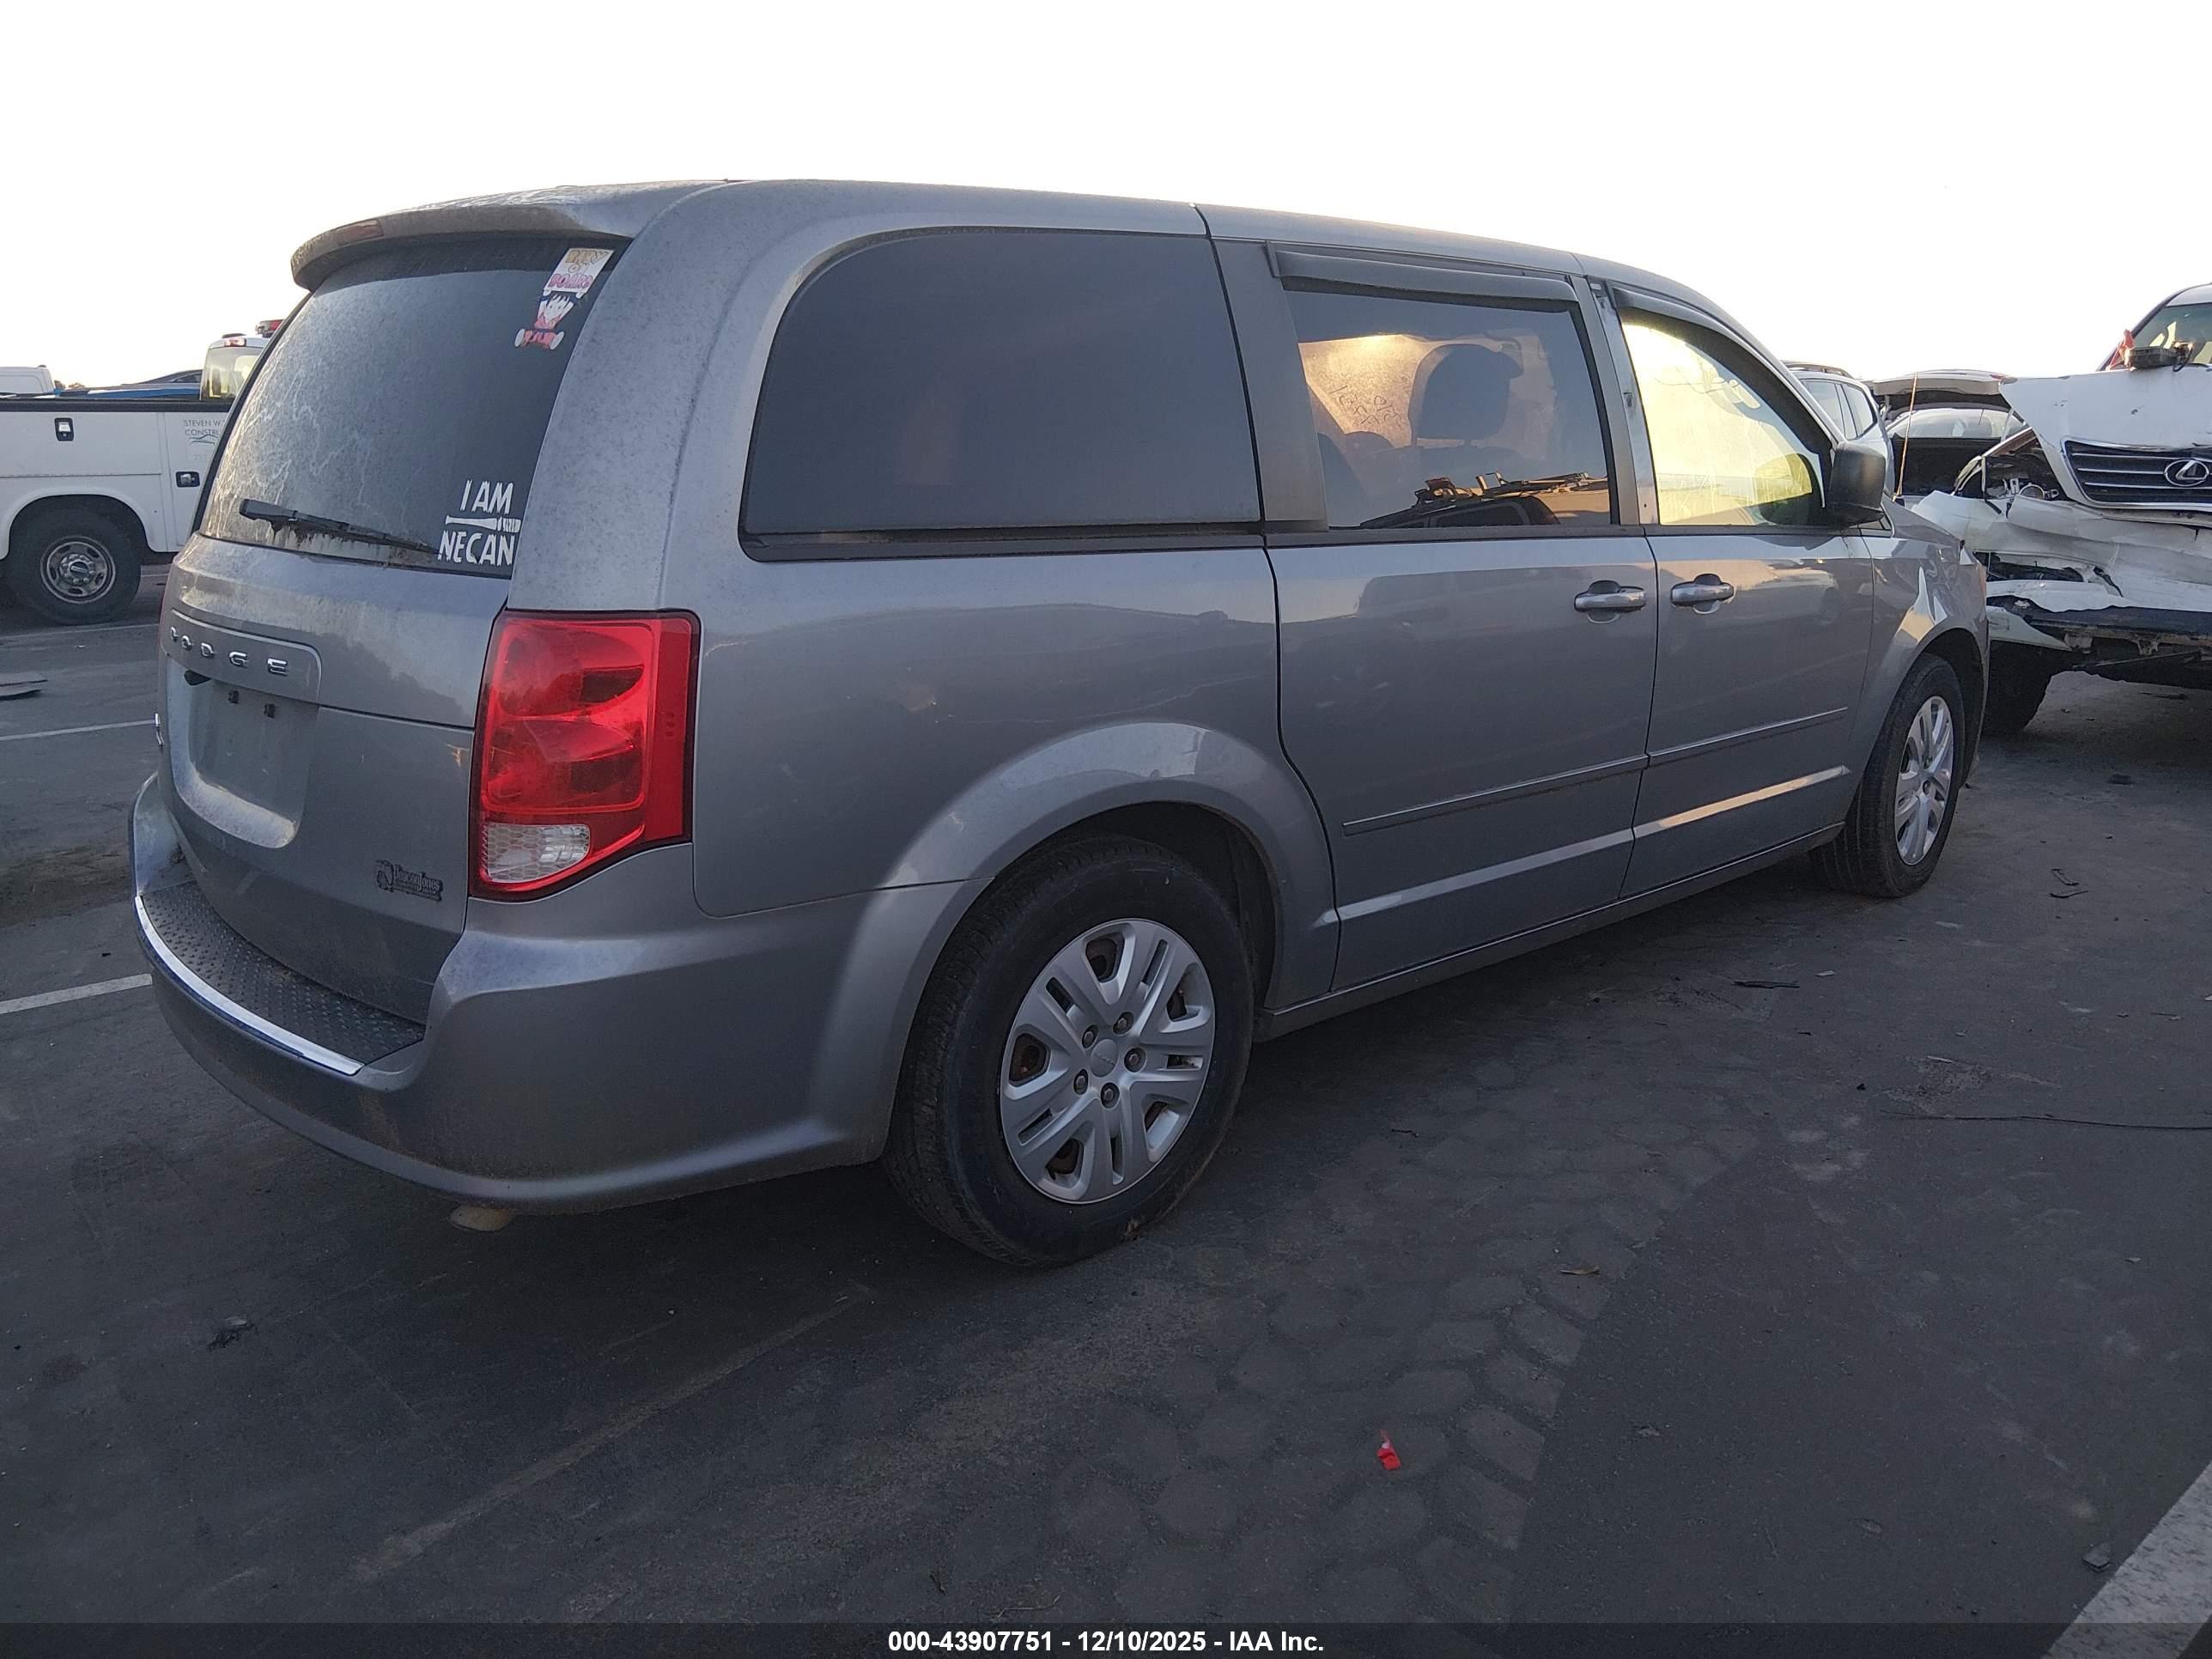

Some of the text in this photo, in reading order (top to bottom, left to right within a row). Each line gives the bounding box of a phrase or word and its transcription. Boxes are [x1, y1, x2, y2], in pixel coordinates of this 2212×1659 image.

[547, 273, 593, 289] BOARD
[460, 479, 514, 514] I AM
